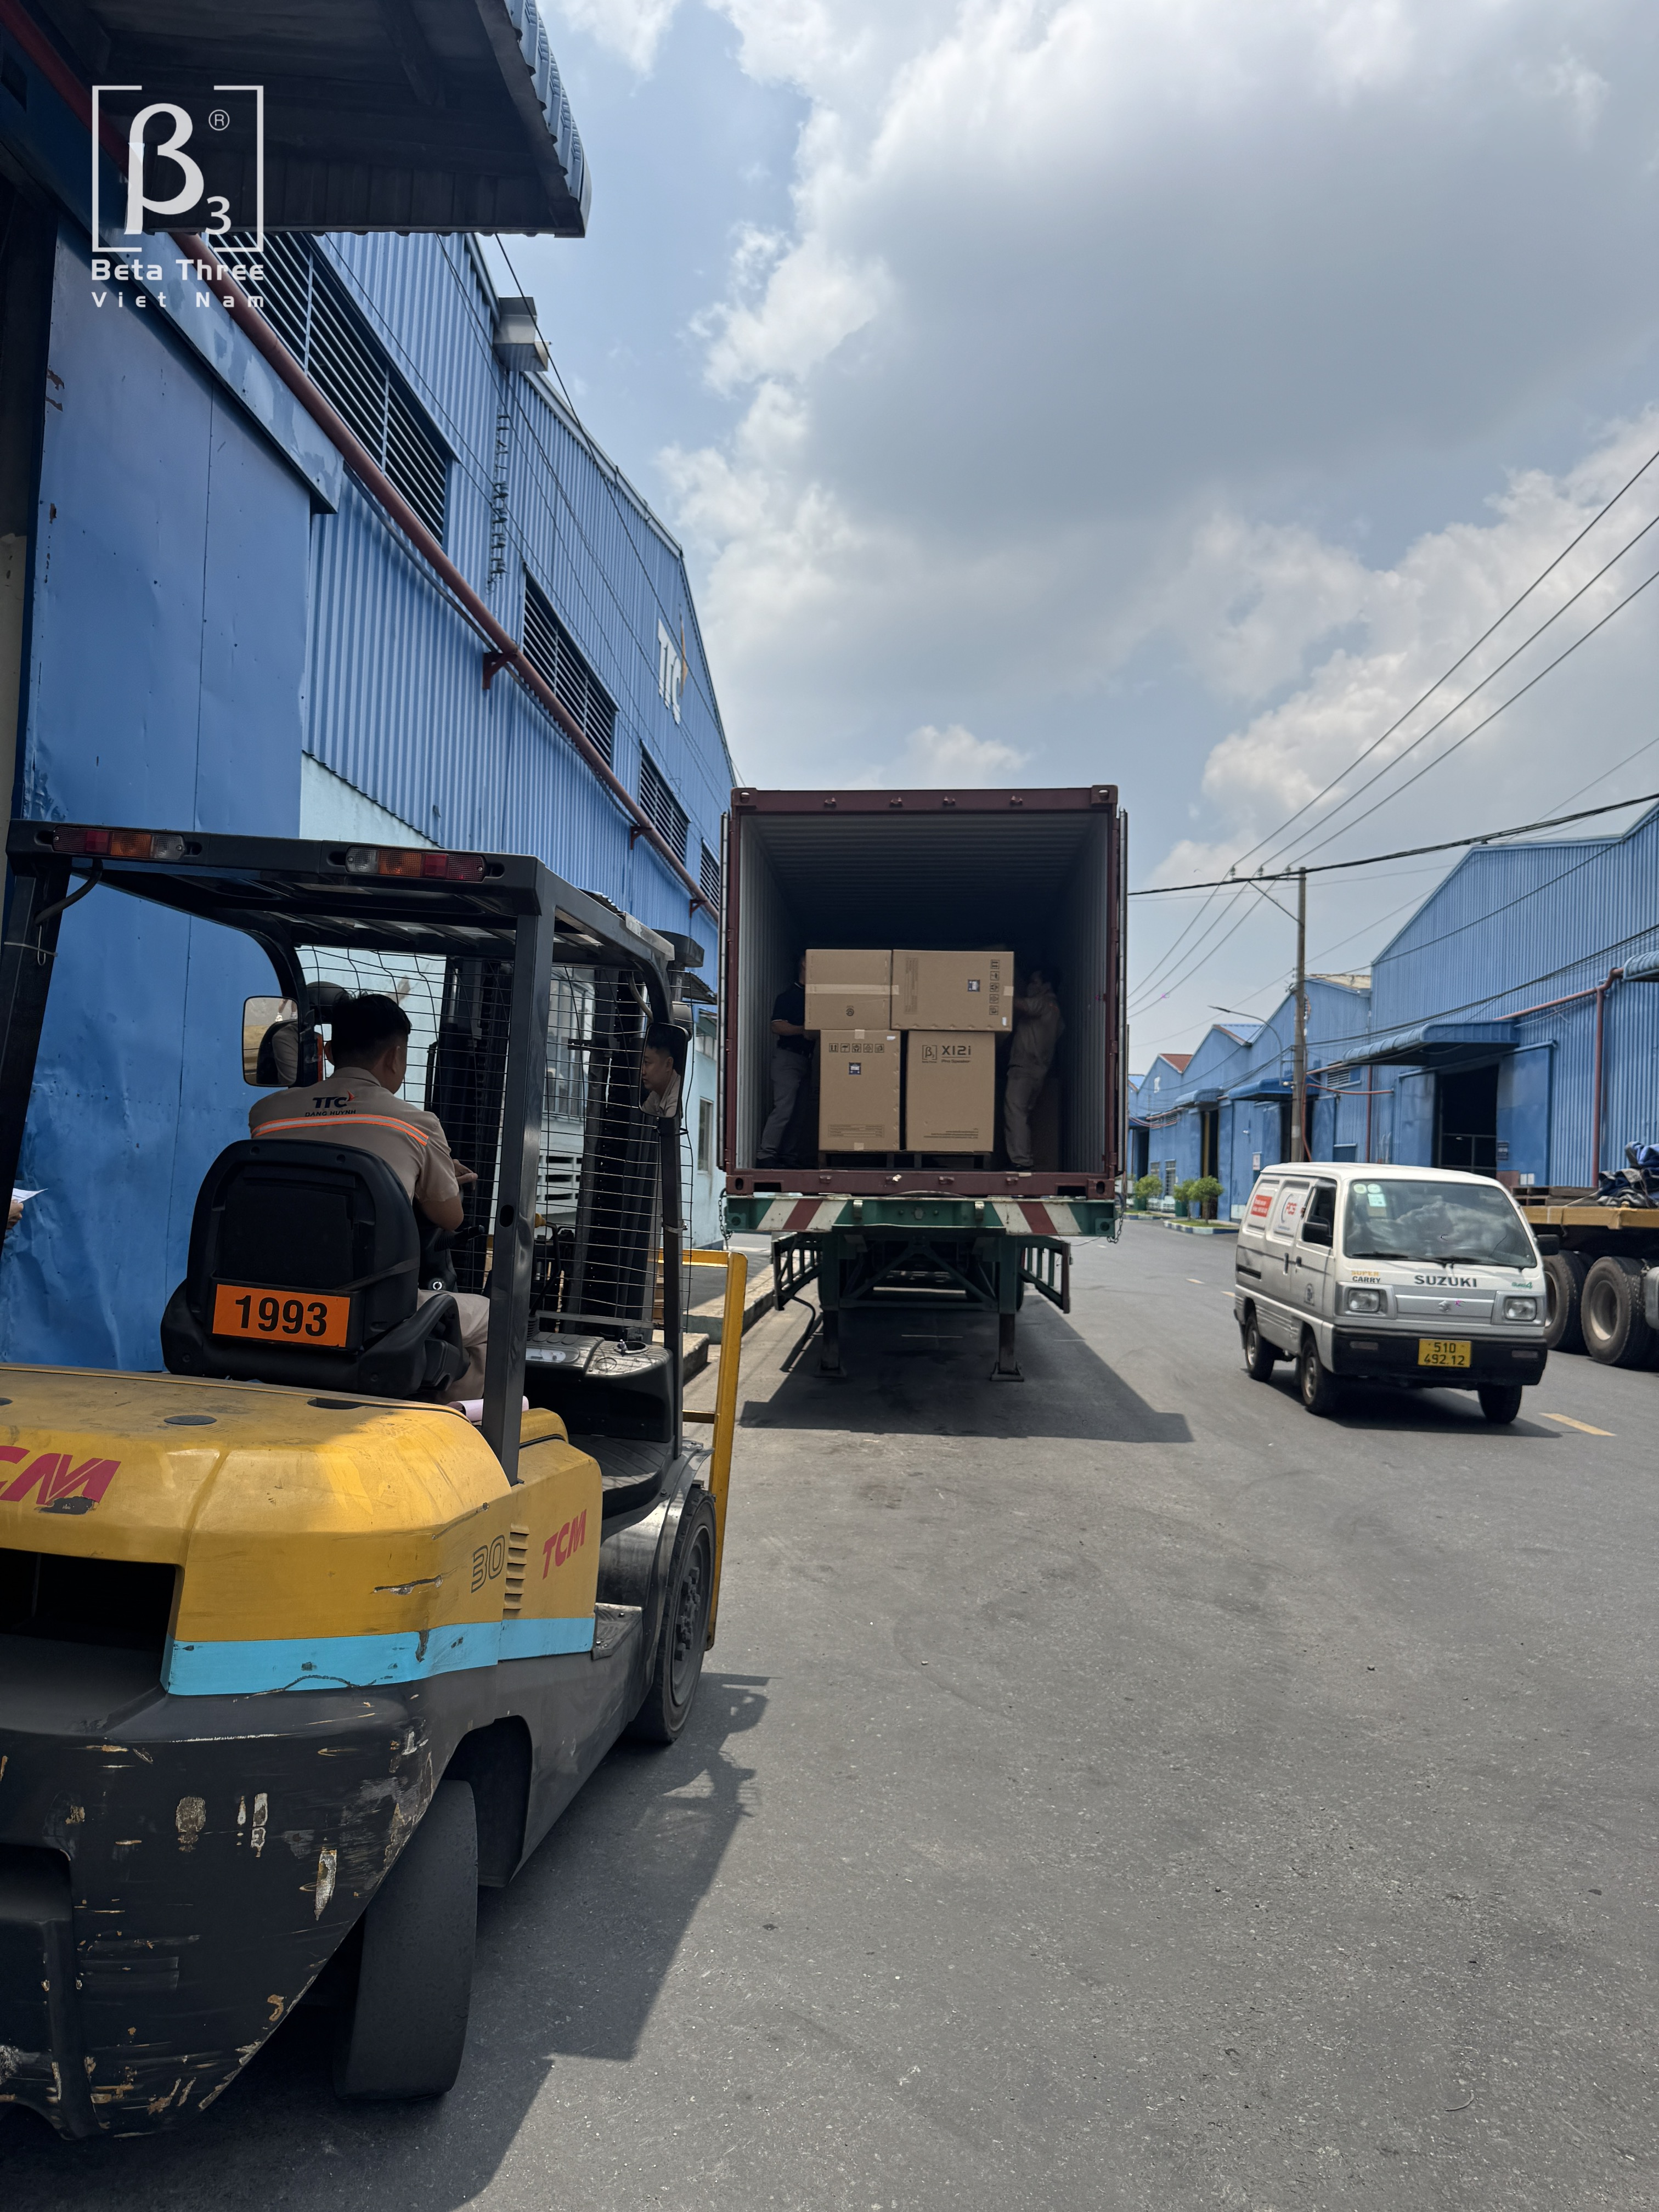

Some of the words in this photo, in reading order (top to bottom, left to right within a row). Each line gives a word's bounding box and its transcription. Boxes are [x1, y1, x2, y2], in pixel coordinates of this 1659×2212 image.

[312, 1097, 348, 1108] TTC
[1414, 1275, 1477, 1288] SUZUKI
[235, 1295, 328, 1336] 1993
[1424, 1353, 1465, 1365] 492.12
[543, 1509, 586, 1580] TCM
[471, 1534, 505, 1593] 30
